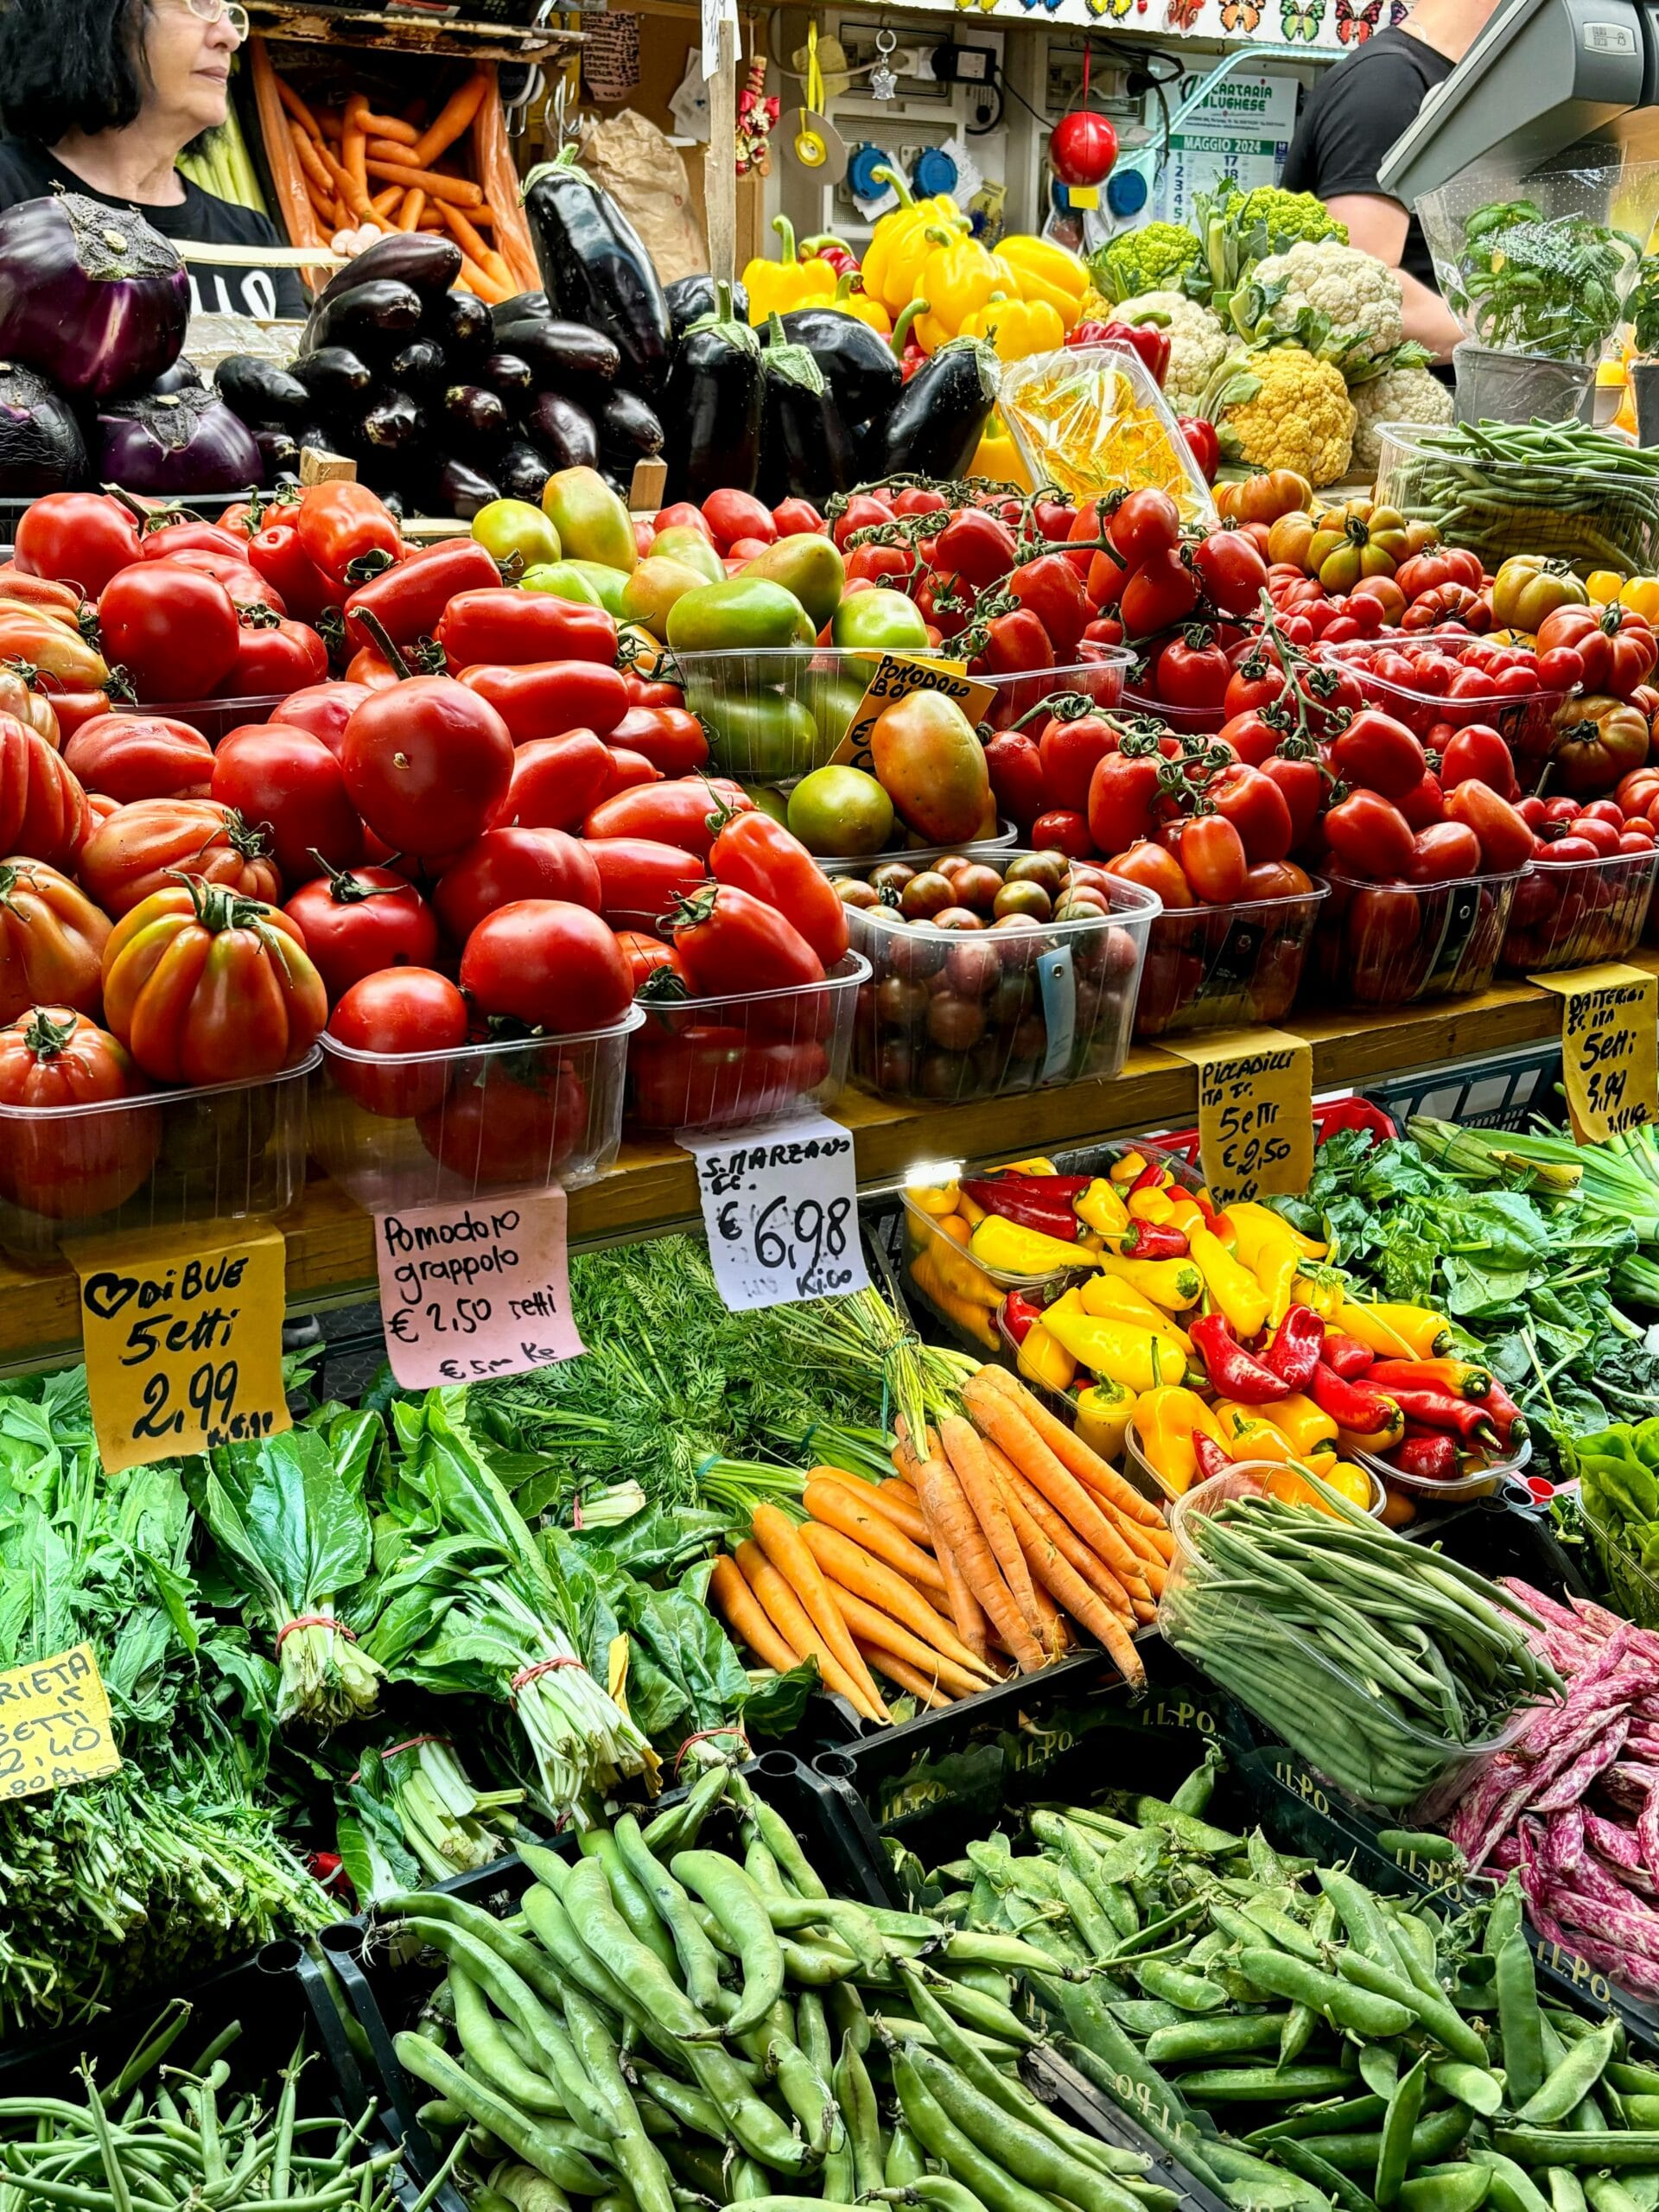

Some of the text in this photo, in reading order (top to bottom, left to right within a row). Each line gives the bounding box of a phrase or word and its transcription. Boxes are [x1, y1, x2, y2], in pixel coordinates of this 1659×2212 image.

[1210, 83, 1273, 99] CARTARIA
[1211, 96, 1267, 111] LUGHESE
[1184, 137, 1231, 151] MAGGIO
[1235, 139, 1262, 153] 2024
[1176, 151, 1238, 167] 1 17
[1174, 166, 1184, 177] 2
[1174, 180, 1184, 191] 3
[1173, 194, 1183, 206] 4
[384, 1211, 520, 1256] Pomodoro
[394, 1245, 519, 1305] grappolo
[385, 1308, 419, 1343] €
[426, 1298, 492, 1333] 2,50
[132, 1360, 238, 1439] 2,99
[0, 1652, 90, 1705] RIETA
